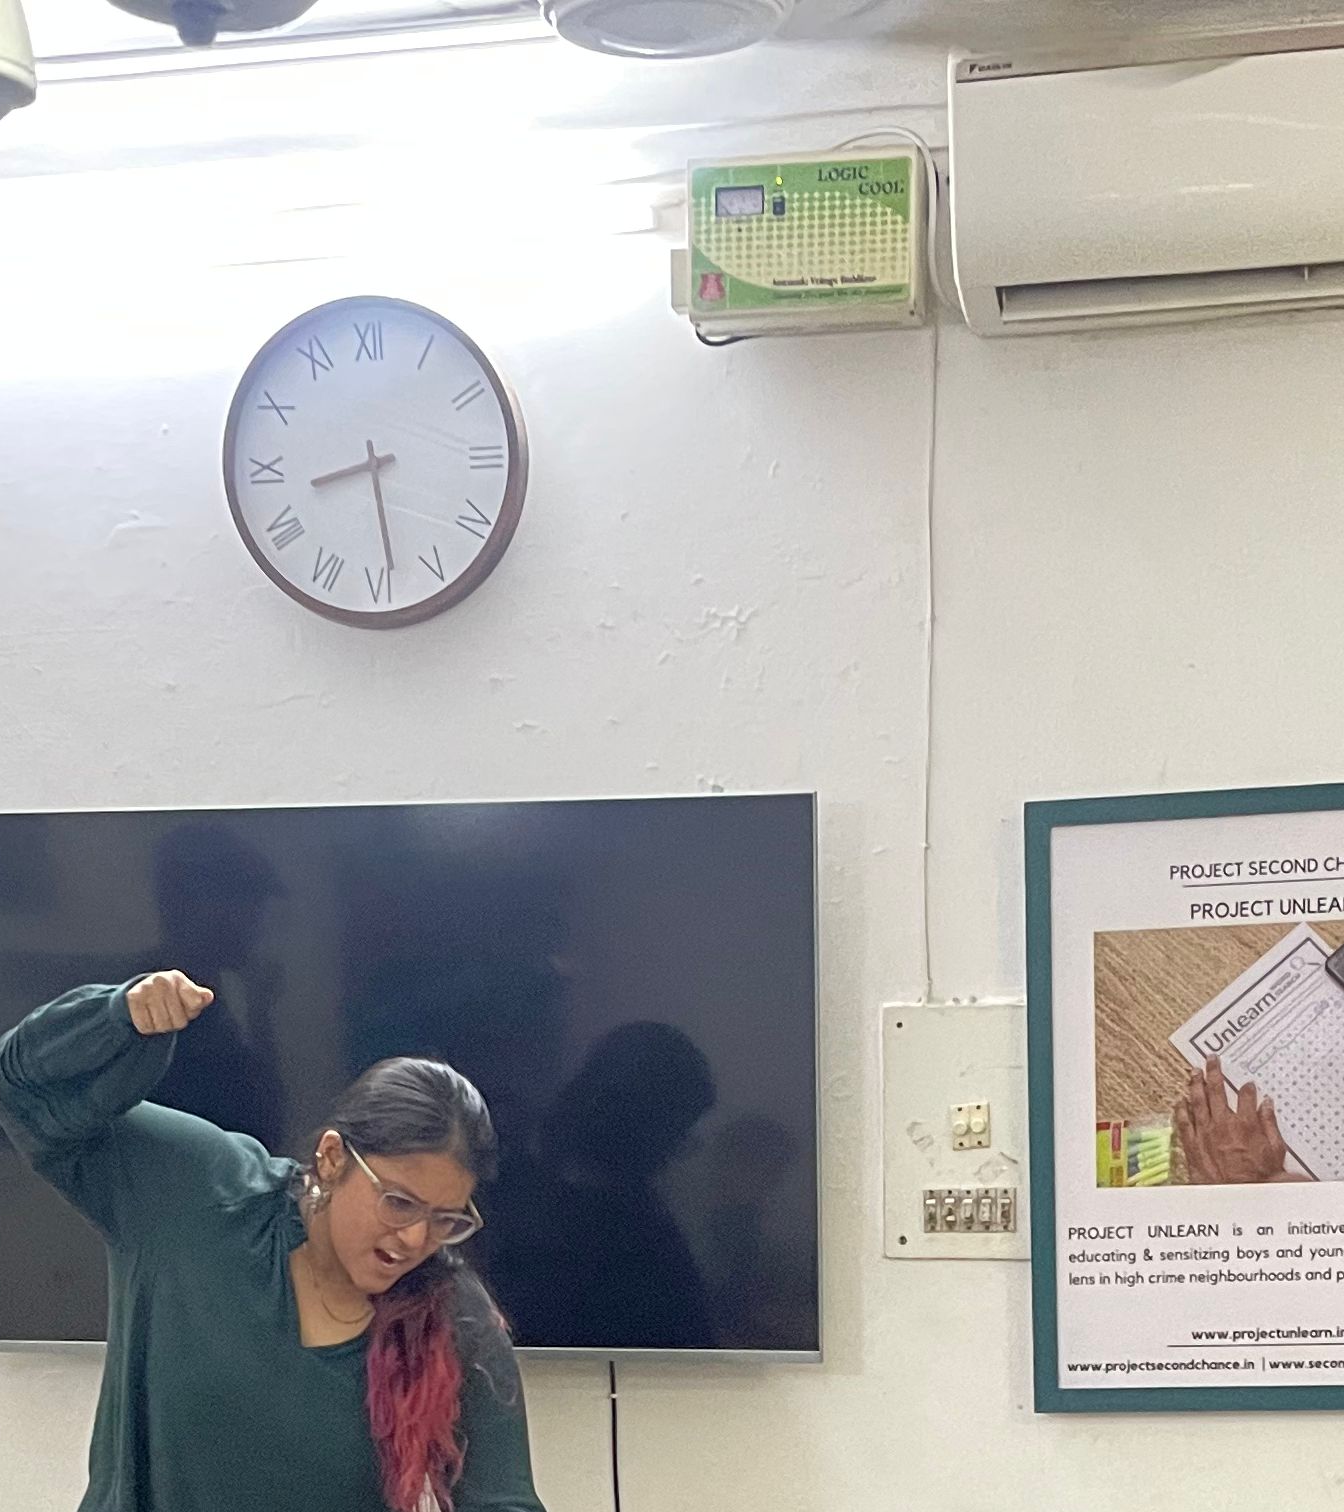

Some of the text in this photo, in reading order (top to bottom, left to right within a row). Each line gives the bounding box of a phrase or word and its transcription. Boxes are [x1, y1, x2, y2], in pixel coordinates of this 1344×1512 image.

[817, 166, 869, 182] LOGIC
[858, 180, 905, 196] COOL
[353, 320, 384, 362] XII
[295, 334, 334, 381] XI
[257, 391, 296, 426] X
[312, 546, 345, 592] VII
[418, 545, 445, 583] V
[364, 565, 392, 604] VI
[1169, 861, 1243, 880] PROJECT
[1248, 858, 1318, 876] SECOND
[1190, 900, 1274, 919] PROJECT
[1203, 990, 1277, 1053] Unlearn
[1068, 1226, 1134, 1240] PROJECT
[1147, 1224, 1219, 1238] UNLEARN
[1232, 1223, 1243, 1236] is
[1256, 1226, 1274, 1236] an
[1068, 1249, 1136, 1264] educating
[1143, 1248, 1153, 1261] &
[1159, 1248, 1229, 1263] sensitizing
[1236, 1245, 1269, 1261] boys
[1276, 1244, 1302, 1258] and
[1068, 1272, 1095, 1286] lens
[1099, 1272, 1110, 1285] in
[1114, 1271, 1144, 1287] high
[1148, 1271, 1185, 1284] crime
[1189, 1269, 1301, 1286] neighbourhoods
[1305, 1268, 1331, 1281] and
[1067, 1357, 1255, 1374] www.projectsecondchance.in
